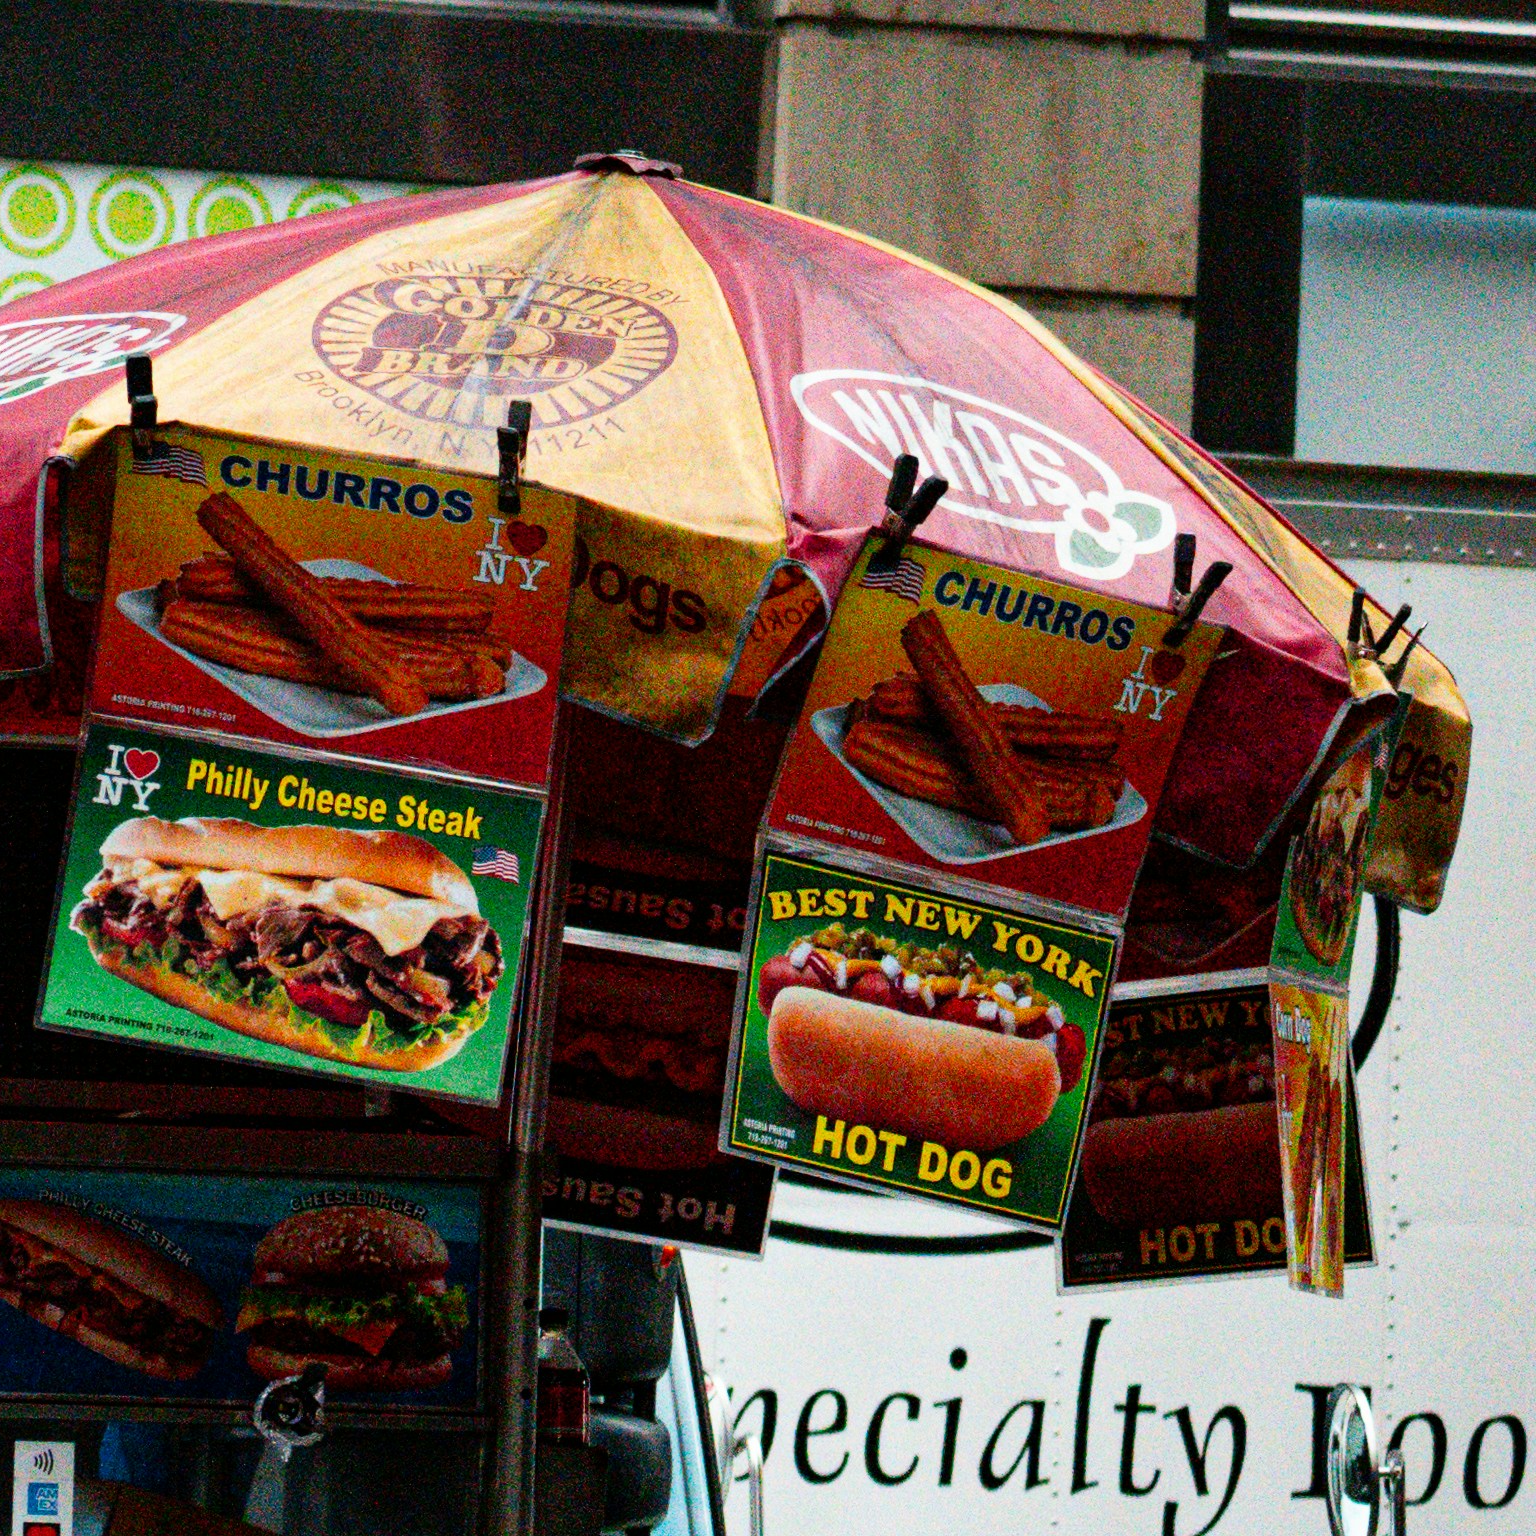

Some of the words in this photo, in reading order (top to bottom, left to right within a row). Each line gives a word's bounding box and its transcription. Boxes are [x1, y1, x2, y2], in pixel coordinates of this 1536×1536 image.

[393, 281, 639, 337] GOLDEN
[378, 352, 585, 380] BRAND
[832, 388, 1076, 507] NIKAS
[218, 454, 475, 524] CHURROS
[485, 517, 507, 554] I
[473, 551, 550, 592] NY
[932, 569, 1137, 653] CHURROS
[1127, 645, 1152, 684] I
[1111, 677, 1179, 725] NY
[103, 744, 125, 776] I
[91, 775, 160, 812] NY
[185, 758, 268, 811] Philly
[277, 775, 388, 824] Cheese
[396, 795, 485, 840] Steak
[768, 886, 875, 922] BEST
[883, 895, 984, 942] NEW
[991, 917, 1105, 999] YORK
[65, 1008, 106, 1024] ASTORIA
[107, 1015, 154, 1032] PRINTING
[1153, 1002, 1230, 1034] NEW
[812, 1114, 908, 1173] HOT
[916, 1140, 1015, 1201] DOG
[37, 1187, 91, 1208] PHILLY
[150, 1227, 195, 1268] STEAK
[288, 1190, 427, 1221] CHEESEBURGER
[1140, 1222, 1220, 1266] HOT
